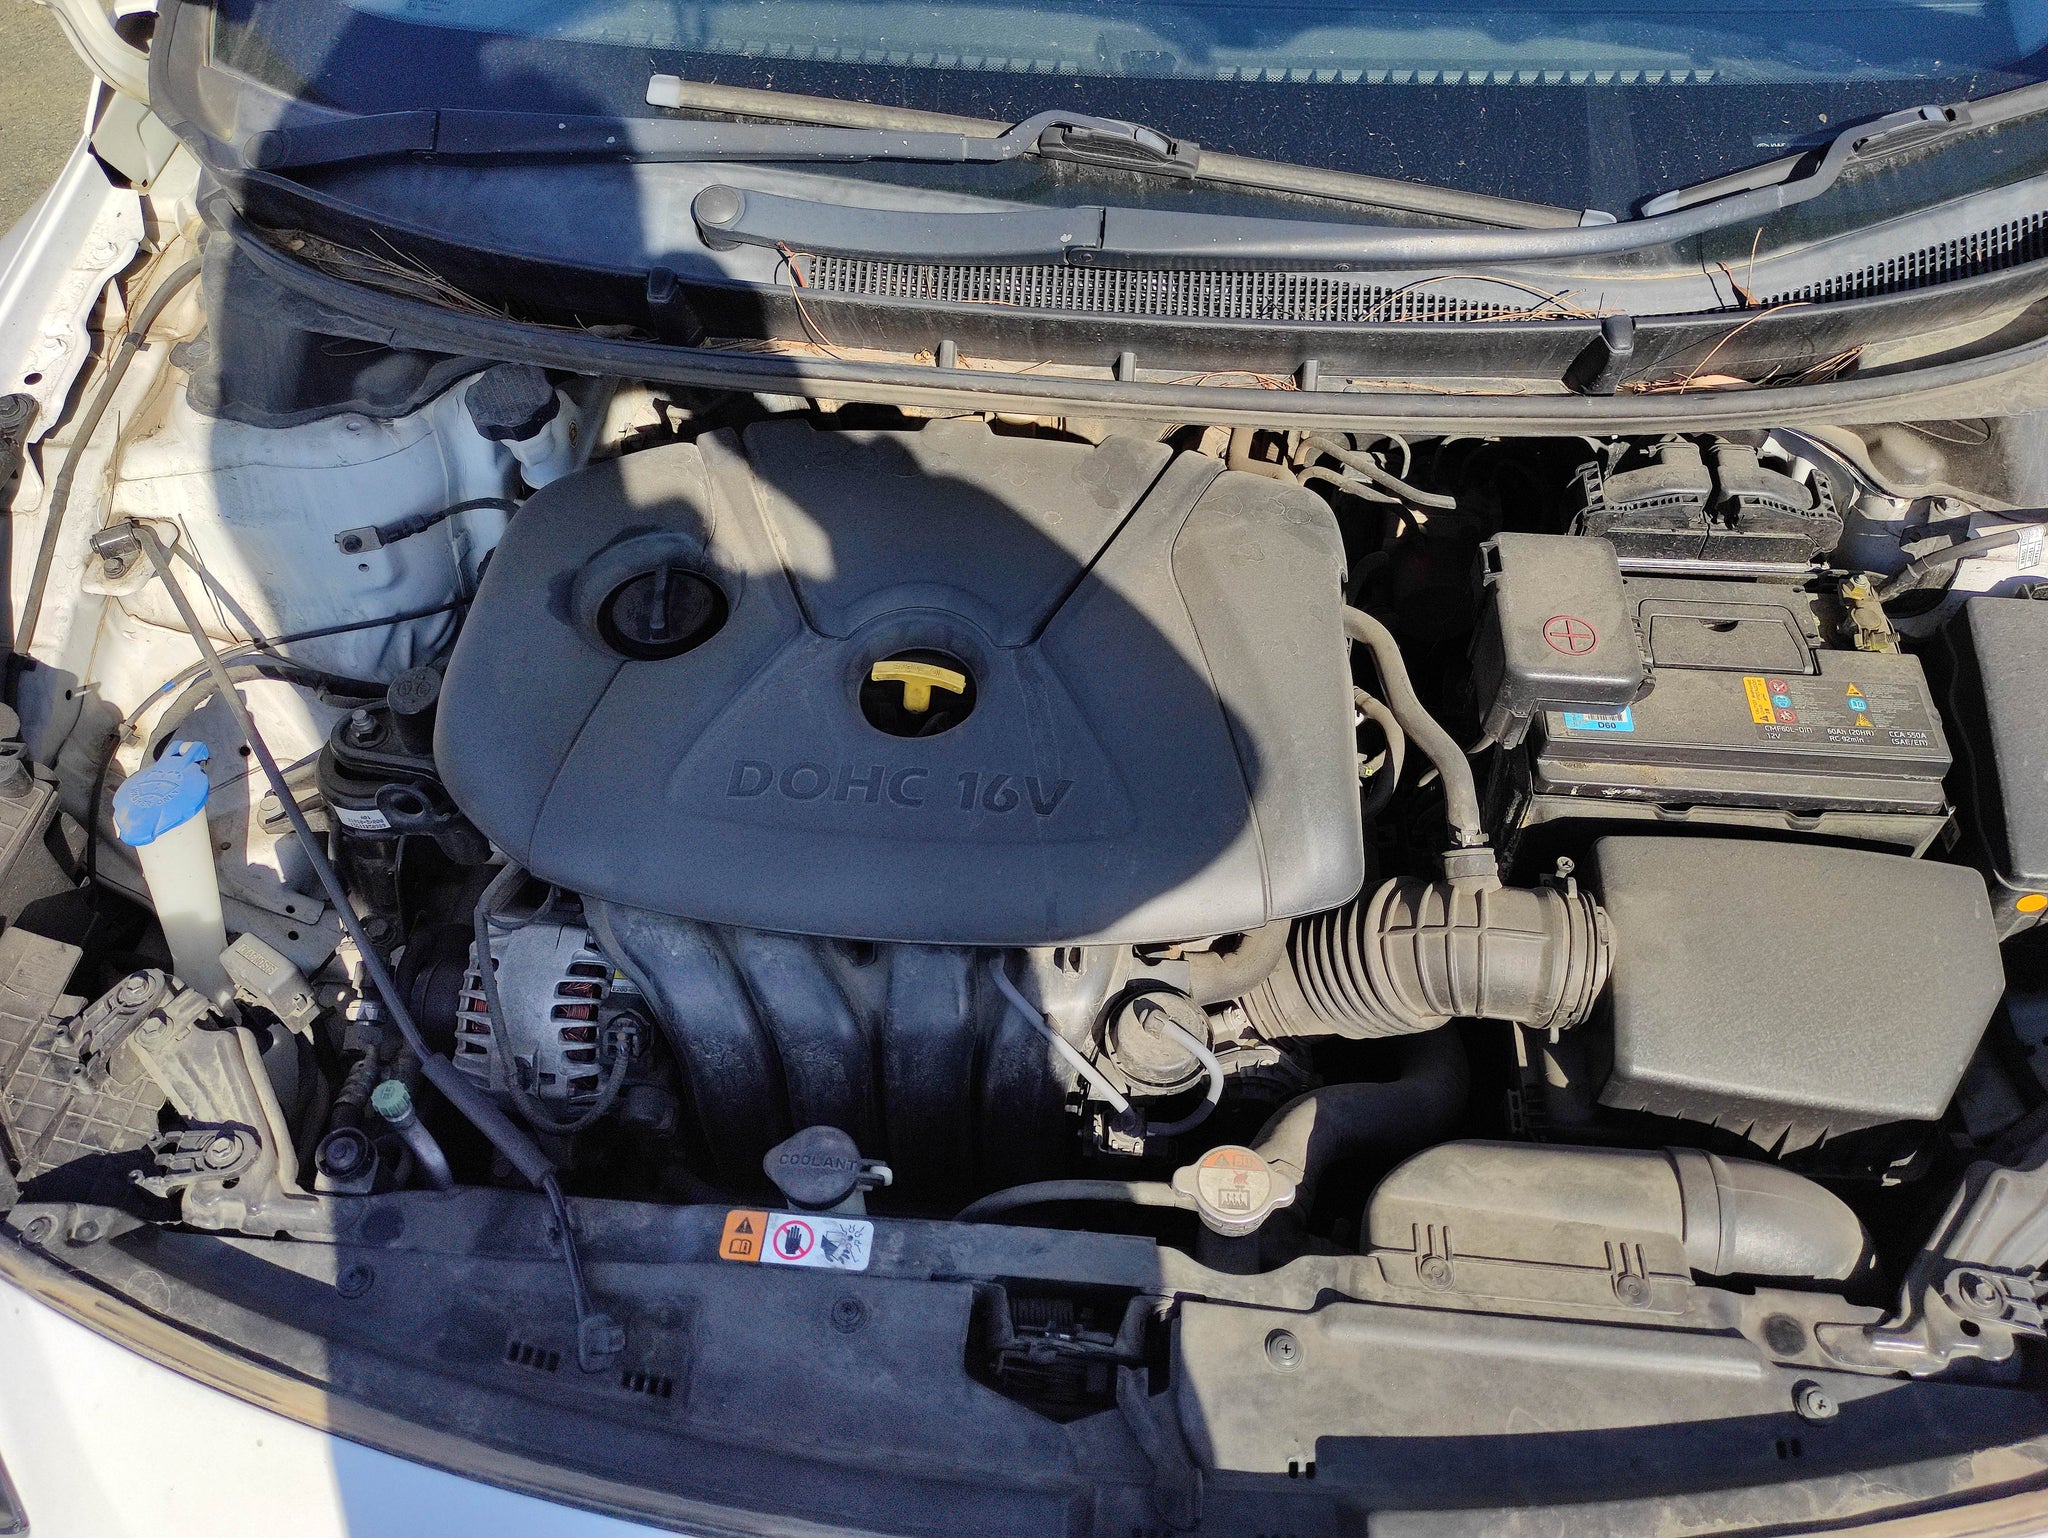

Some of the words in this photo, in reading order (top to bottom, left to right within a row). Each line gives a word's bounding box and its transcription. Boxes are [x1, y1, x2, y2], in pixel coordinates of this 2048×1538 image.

[1597, 721, 1617, 729] D60
[1829, 735, 1841, 743] RC
[1888, 730, 1906, 739] CCA
[1906, 731, 1927, 740] 550A
[726, 758, 931, 809] DOHC
[957, 771, 1076, 818] 16V
[779, 1153, 858, 1173] COOLANT
